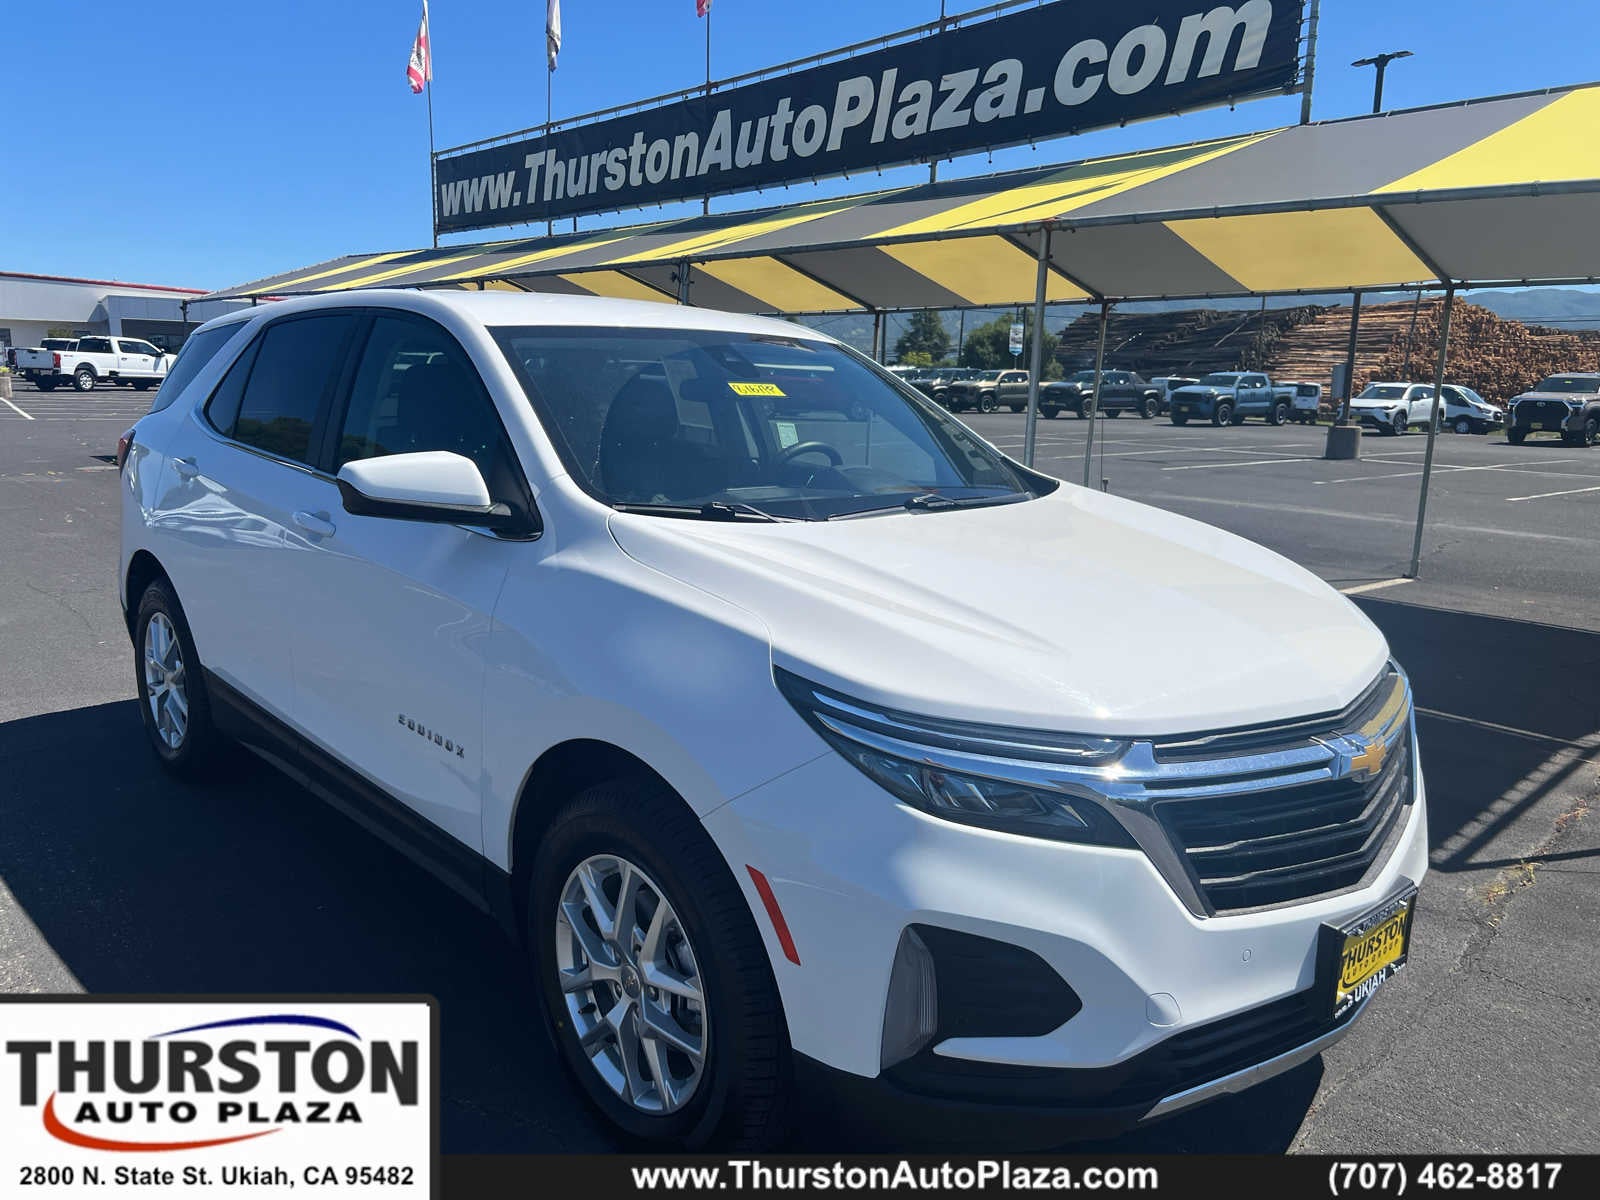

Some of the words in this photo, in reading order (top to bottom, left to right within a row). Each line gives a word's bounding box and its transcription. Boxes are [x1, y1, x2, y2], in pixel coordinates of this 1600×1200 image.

[441, 0, 1273, 217] www.ThurstonAutoPlaza.com
[398, 713, 465, 759] EQUINOX
[1354, 967, 1386, 1002] UKIAH
